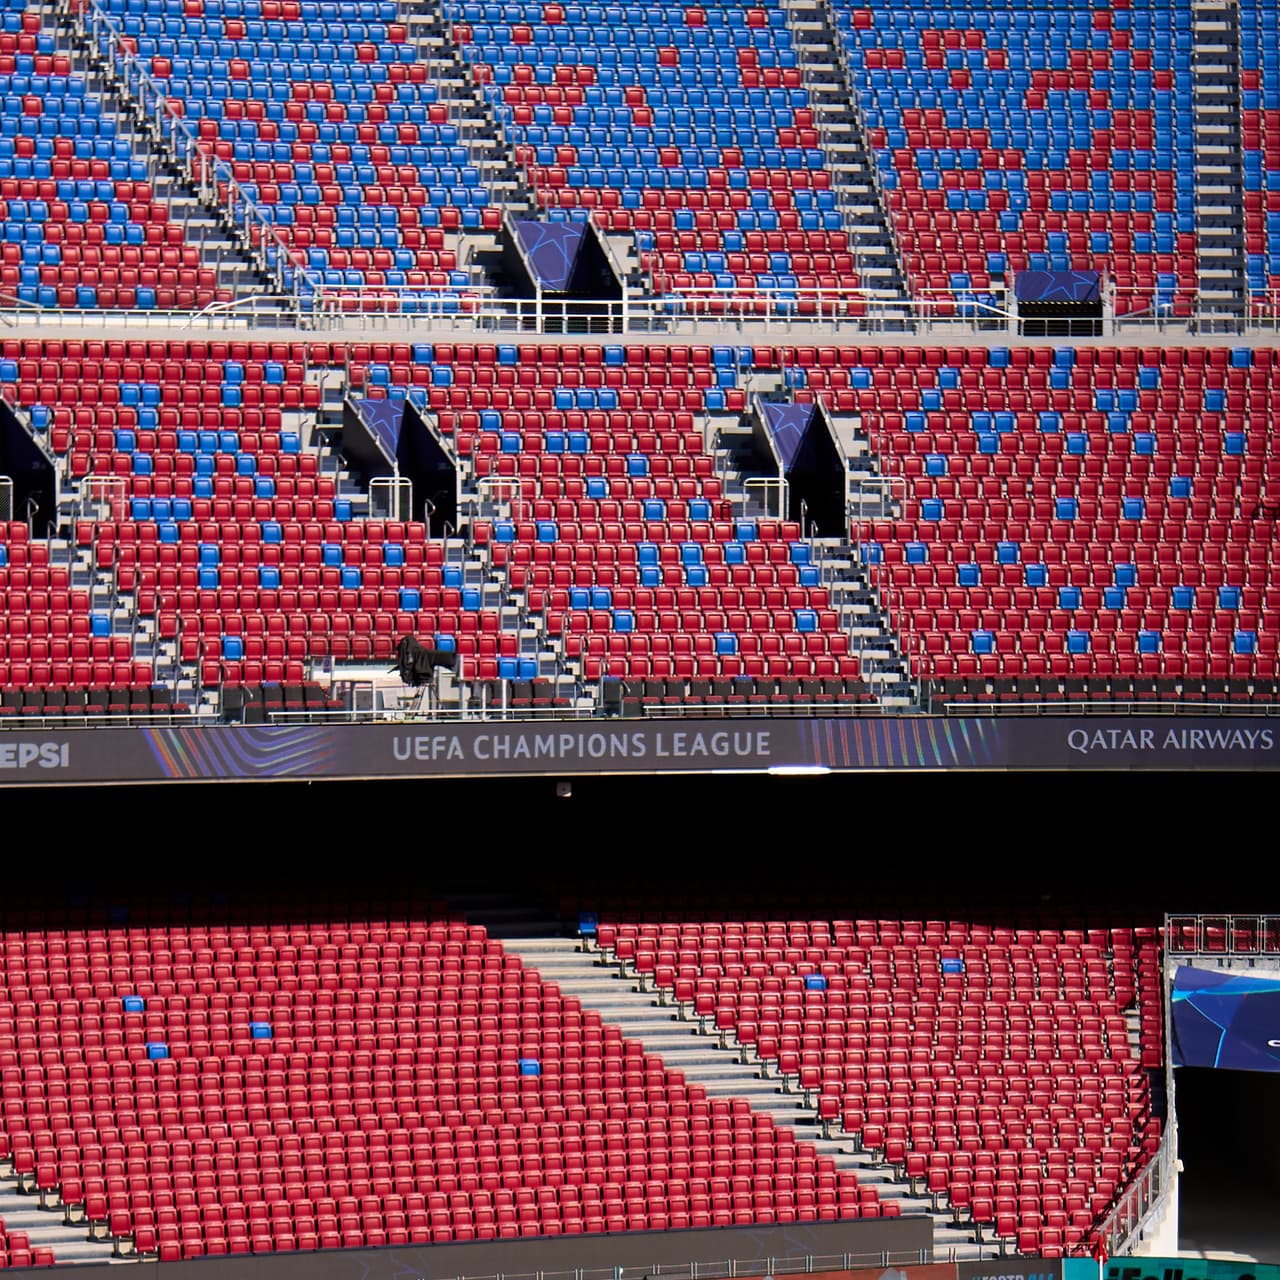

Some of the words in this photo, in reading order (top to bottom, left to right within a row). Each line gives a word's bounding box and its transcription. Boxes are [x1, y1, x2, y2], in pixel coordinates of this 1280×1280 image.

[392, 735, 464, 761] UEFA
[473, 732, 646, 760] CHAMPIONS
[655, 731, 771, 757] LEAGUE
[1067, 729, 1156, 754] QATAR
[1162, 729, 1274, 751] AIRWAYS
